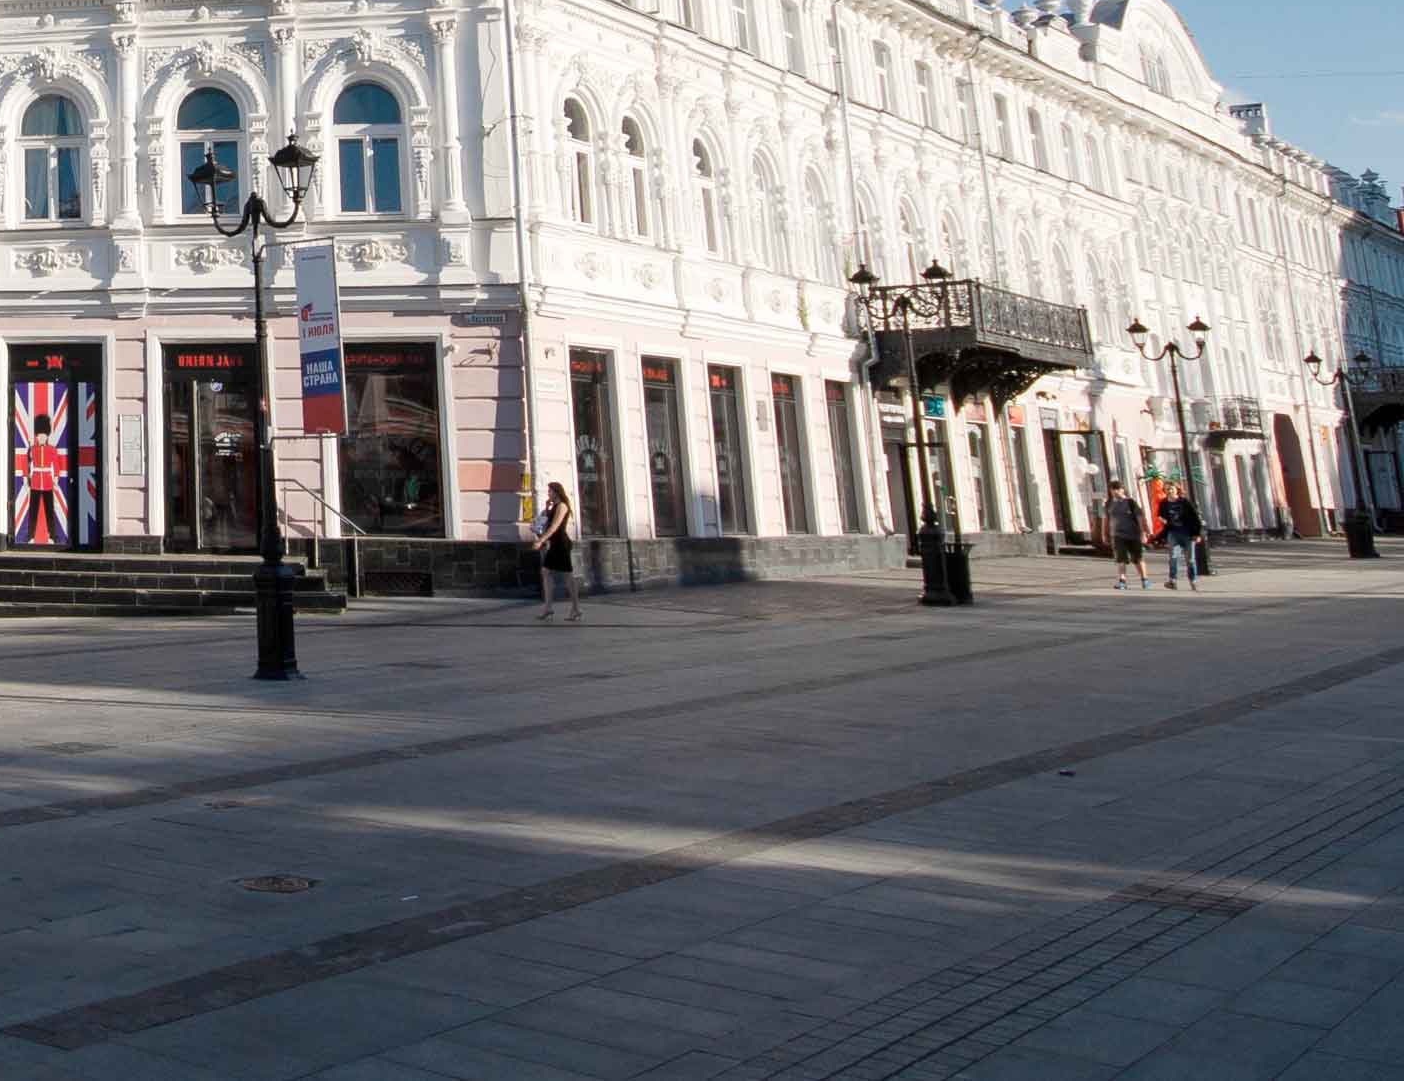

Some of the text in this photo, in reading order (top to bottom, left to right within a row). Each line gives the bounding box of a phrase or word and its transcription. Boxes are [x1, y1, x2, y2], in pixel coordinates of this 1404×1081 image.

[308, 324, 335, 338] ИЮЛЯ
[178, 354, 213, 367] UNION
[306, 360, 334, 375] НАША
[303, 371, 339, 388] СТРАНА
